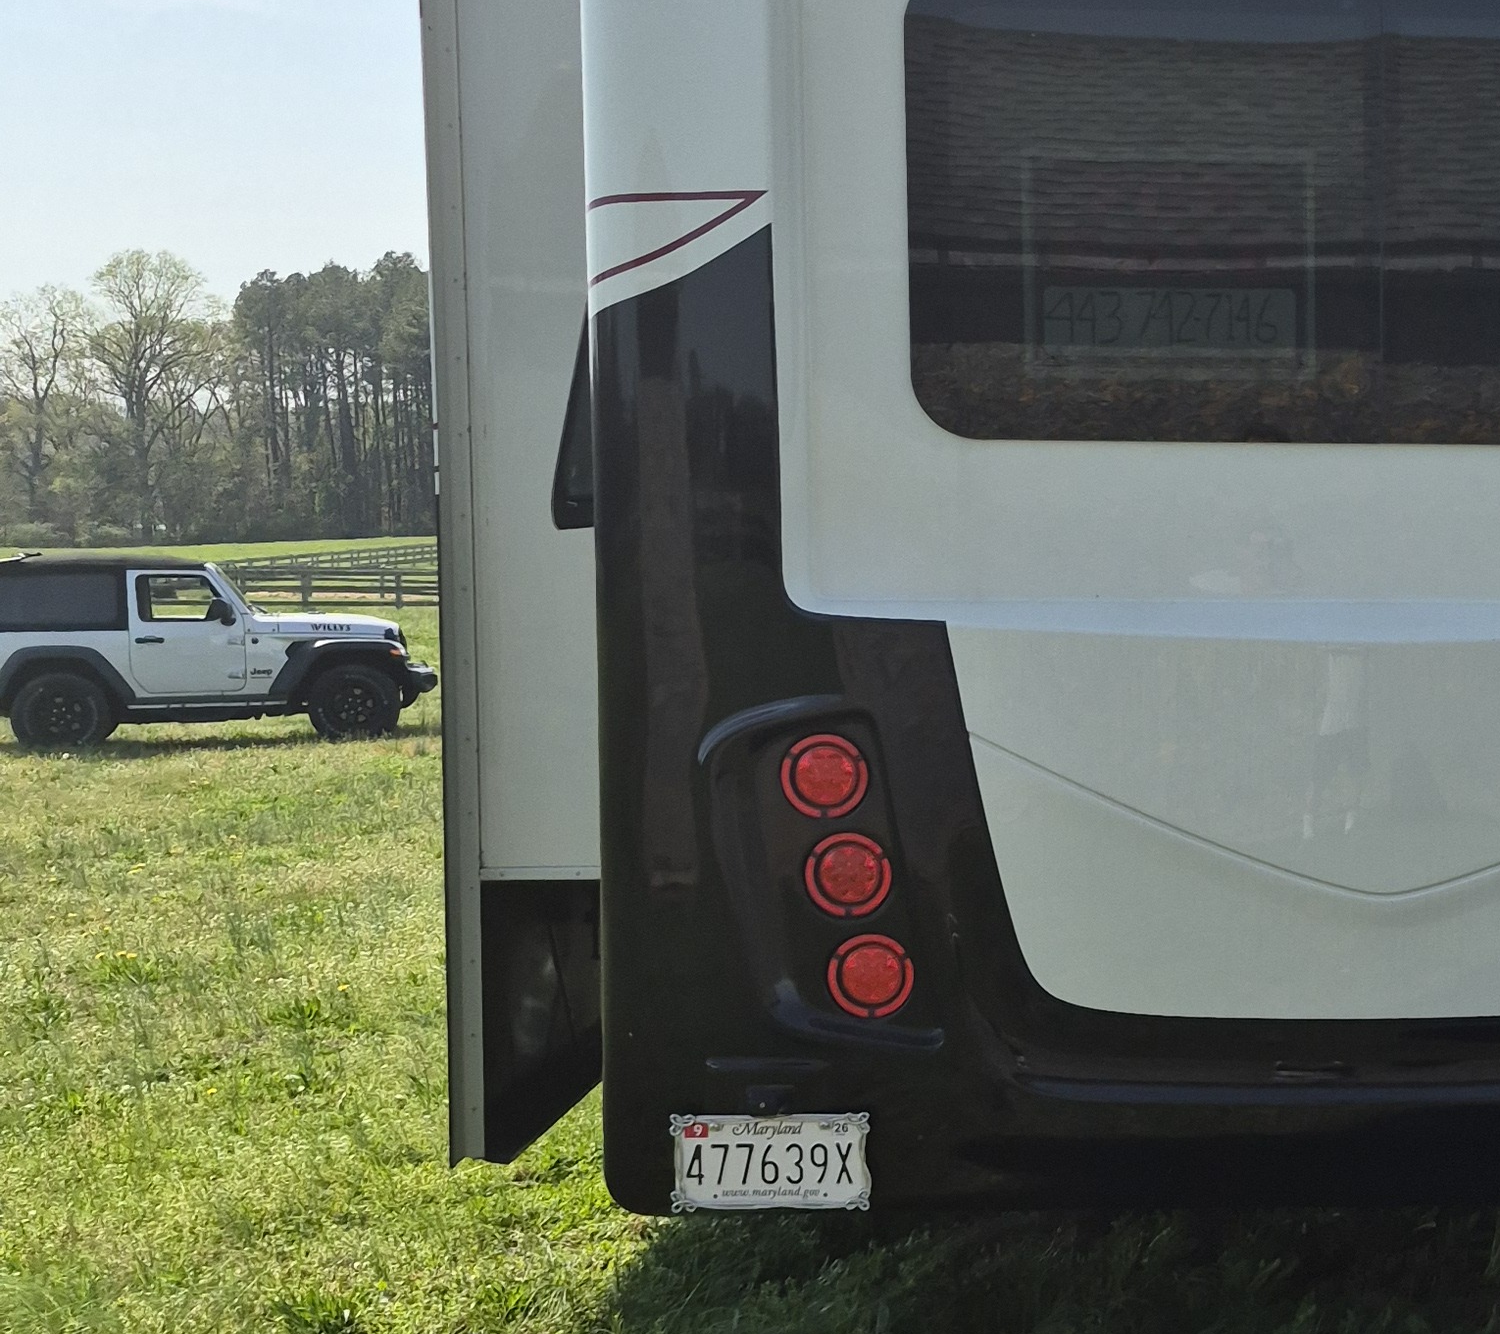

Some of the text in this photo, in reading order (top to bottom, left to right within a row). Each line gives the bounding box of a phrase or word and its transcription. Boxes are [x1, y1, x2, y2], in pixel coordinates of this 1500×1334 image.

[1045, 291, 1278, 345] 443 742-7146
[311, 623, 352, 632] WILLYS
[250, 668, 273, 676] Jeep
[693, 1124, 703, 1136] 9
[732, 1121, 802, 1140] Maryland
[834, 1122, 849, 1133] 26
[686, 1142, 854, 1185] 477639X
[721, 1186, 820, 1200] www.maryland.gov
